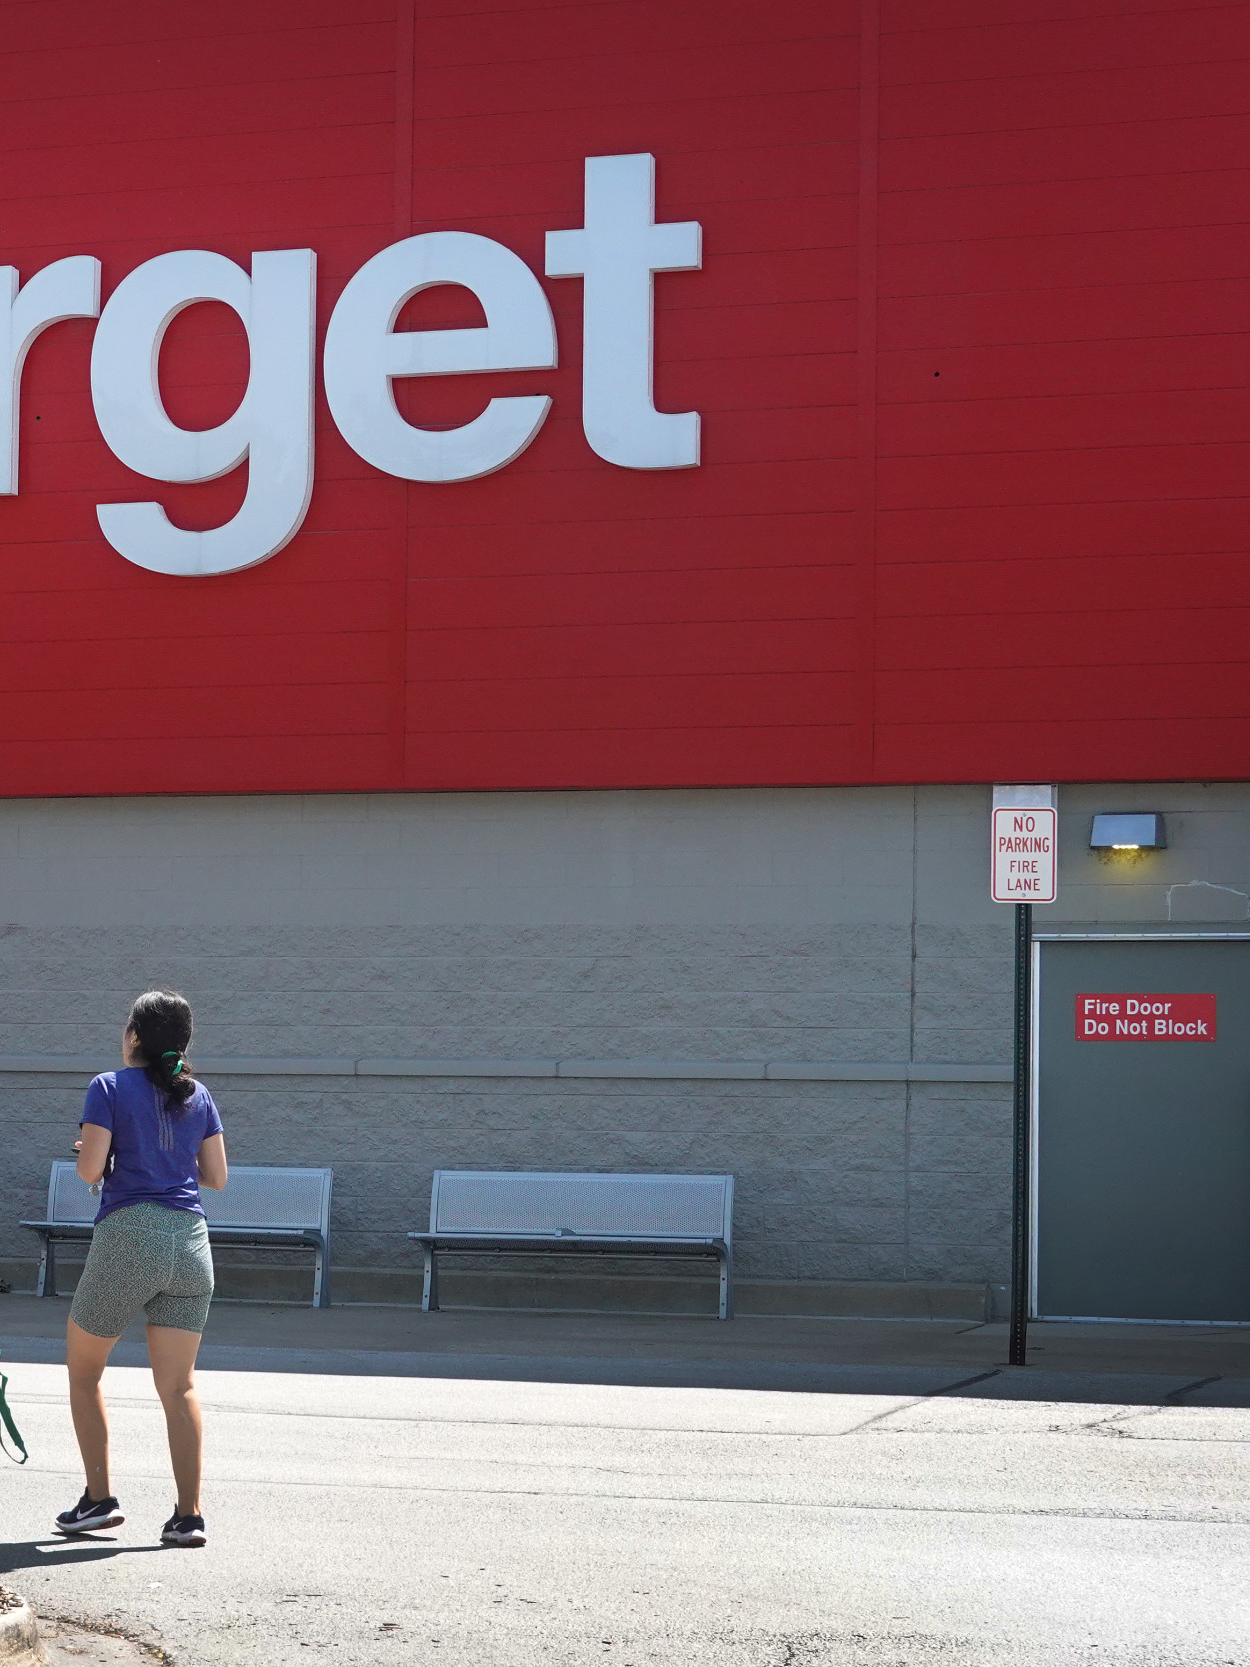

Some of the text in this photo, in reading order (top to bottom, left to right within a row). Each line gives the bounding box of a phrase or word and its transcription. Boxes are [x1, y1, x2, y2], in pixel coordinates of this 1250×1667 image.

[1013, 816, 1035, 832] NO
[998, 836, 1050, 853] PARKING
[1009, 860, 1038, 873] FIRE
[1007, 878, 1040, 891] LANE
[1084, 999, 1172, 1015] Fire Door
[1084, 1019, 1208, 1035] Do Not Block
